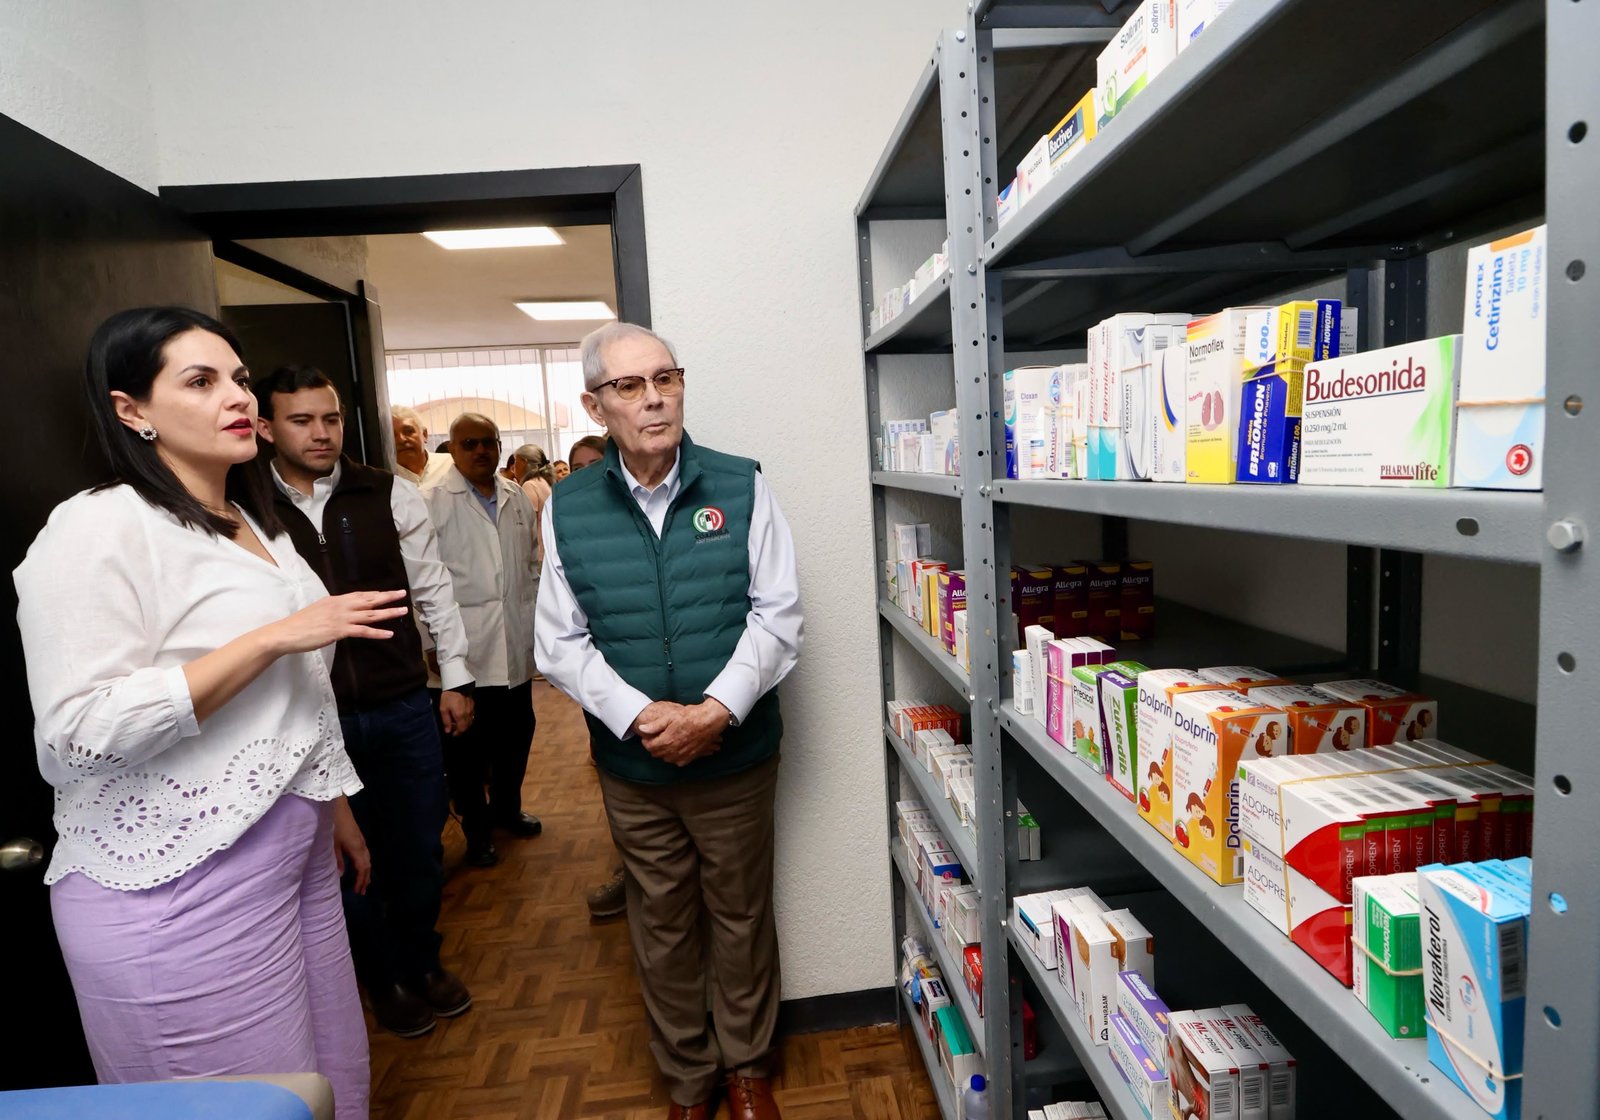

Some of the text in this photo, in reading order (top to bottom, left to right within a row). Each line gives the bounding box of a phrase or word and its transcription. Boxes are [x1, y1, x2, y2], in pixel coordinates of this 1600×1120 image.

[1506, 252, 1517, 295] Tableta
[1517, 249, 1531, 292] 10 mg
[1475, 264, 1484, 317] APOTEX
[1485, 256, 1504, 351] Cetirizina
[1189, 339, 1225, 358] Normoflex
[1259, 326, 1269, 360] 100
[1306, 357, 1426, 402] Budesonida
[1249, 384, 1266, 476] BRIOMON
[1305, 406, 1342, 420] SUSPENSIÓN
[1022, 585, 1049, 594] Allegra
[1056, 580, 1082, 589] Allegra
[1090, 579, 1117, 588] Allegra
[1122, 575, 1149, 585] Allegra
[1139, 689, 1172, 719] Dolprin
[1112, 696, 1127, 776] Zukedib
[1174, 711, 1216, 746] Dolprin
[1227, 782, 1240, 848] Dolprin
[1242, 792, 1288, 832] ADOPREN
[1346, 849, 1354, 896] ADOPREN
[1369, 842, 1377, 875] OPREN
[1393, 840, 1401, 872] OPREN
[1424, 905, 1446, 1016] Novakerol
